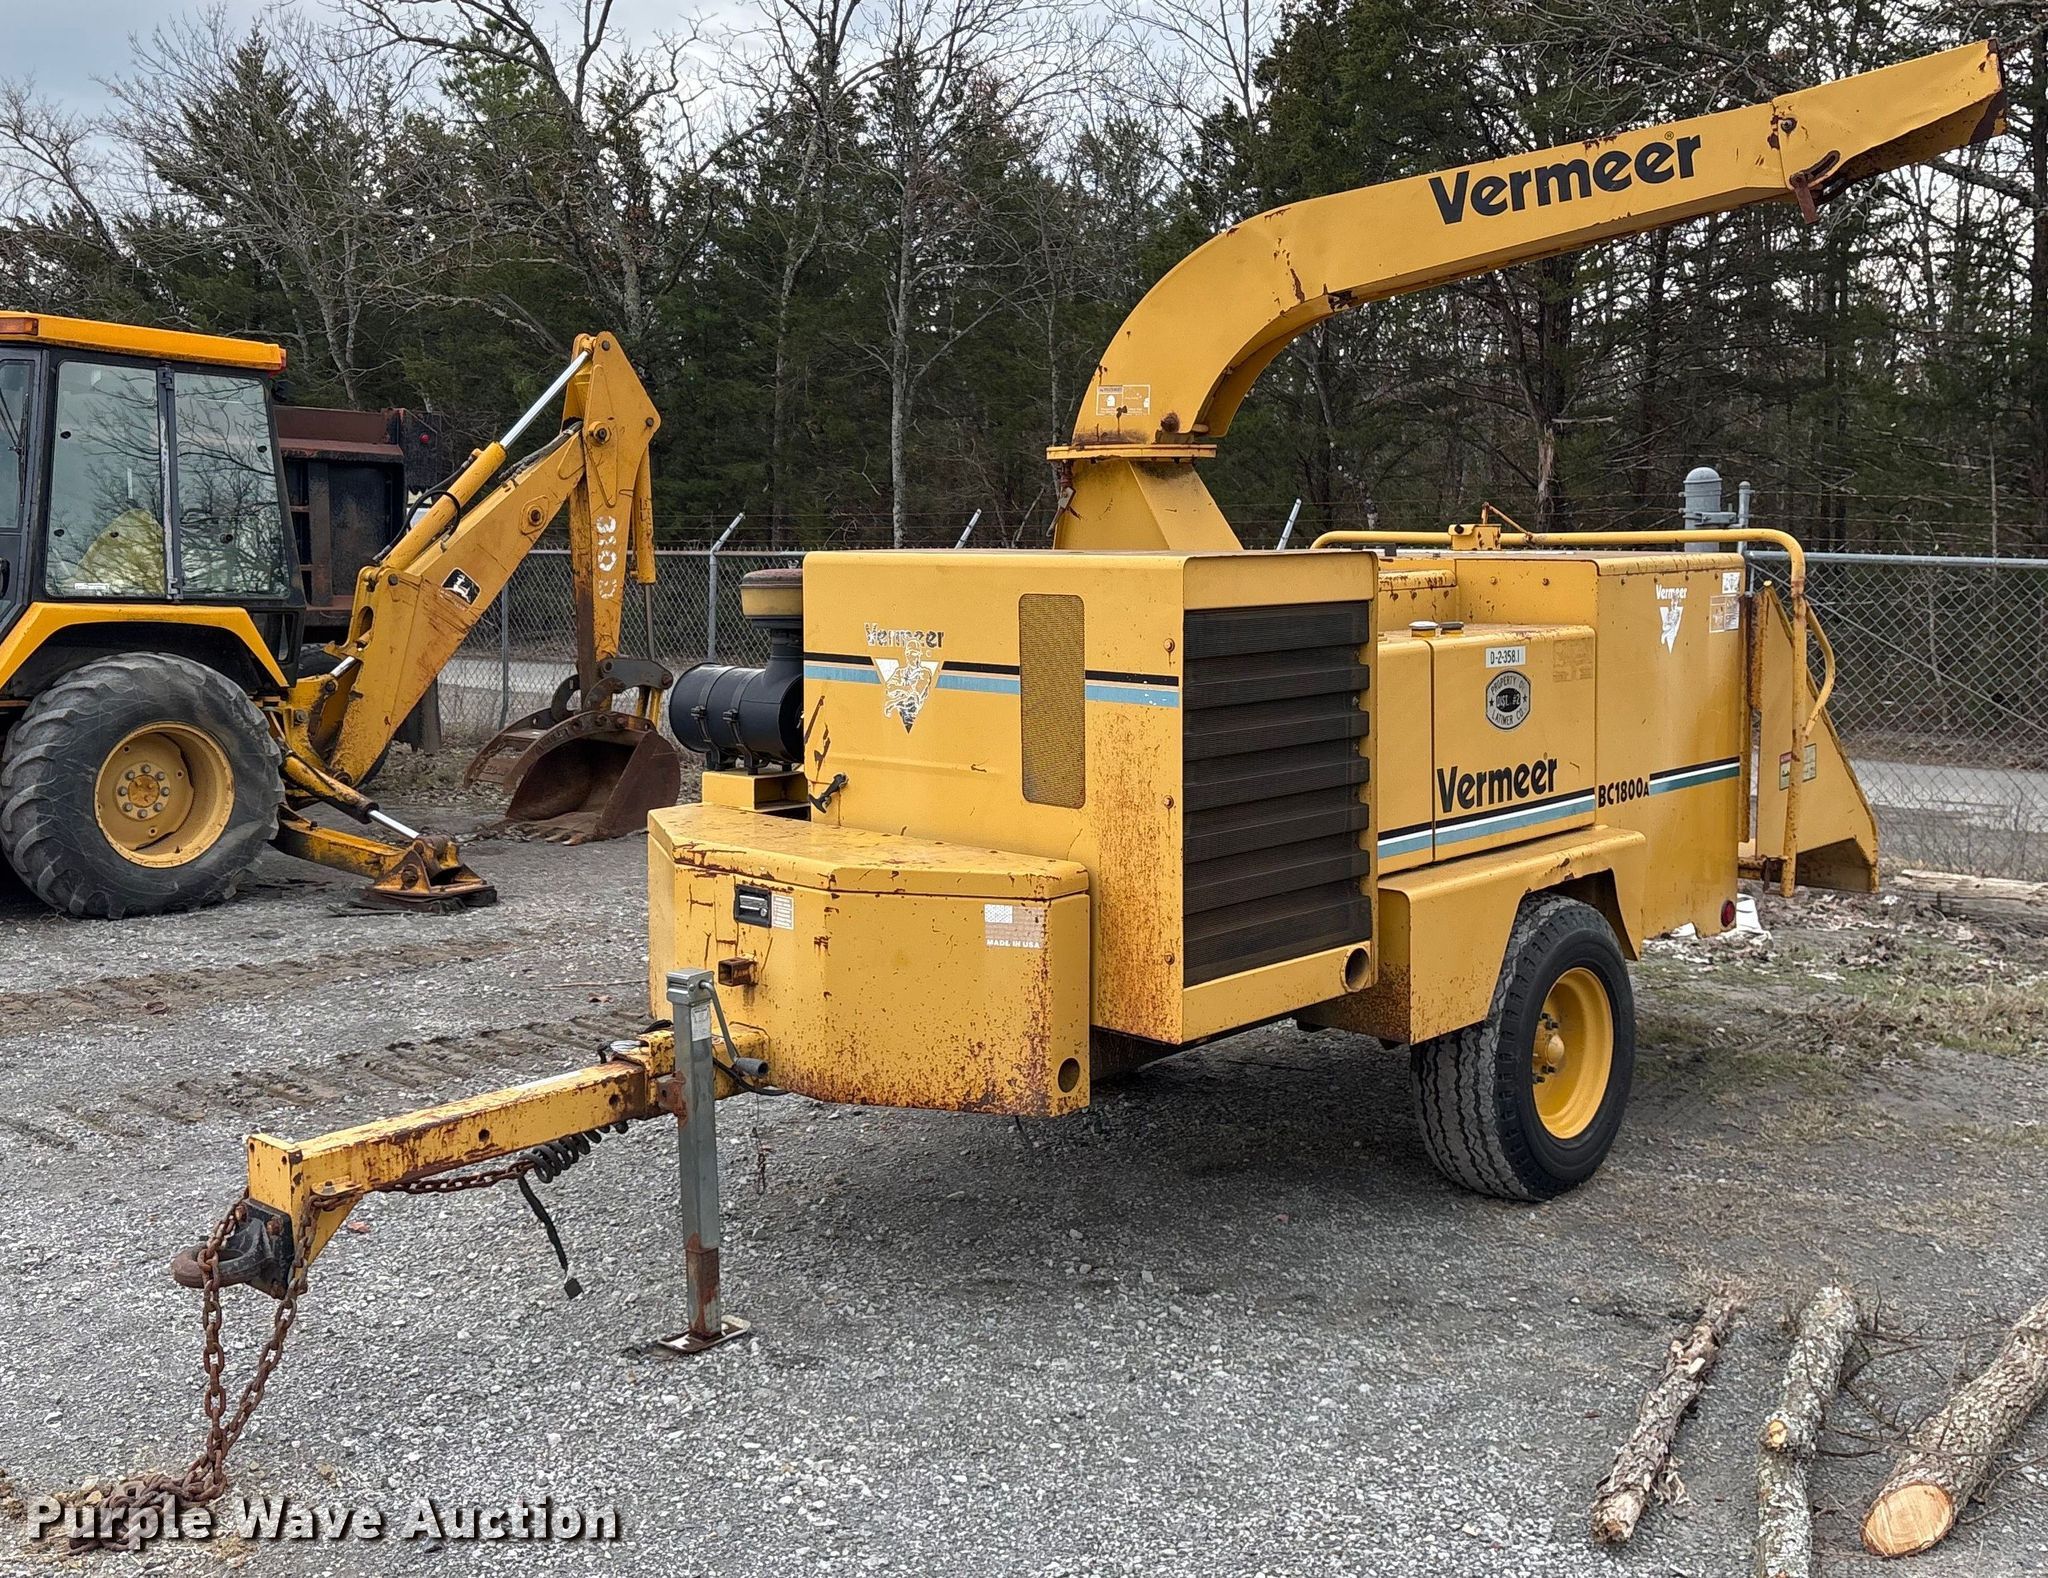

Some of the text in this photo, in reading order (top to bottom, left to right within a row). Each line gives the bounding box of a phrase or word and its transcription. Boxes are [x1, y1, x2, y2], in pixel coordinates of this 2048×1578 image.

[1428, 134, 1702, 225] Vermeer
[1655, 584, 1688, 600] Vermeer
[863, 622, 946, 648] Vermeer
[1491, 675, 1517, 695] PROPERTY
[1491, 709, 1514, 726] LATIMER
[1437, 758, 1557, 813] Vermeer
[1598, 777, 1650, 808] BC1800A
[986, 939, 1040, 949] MADE IN USA
